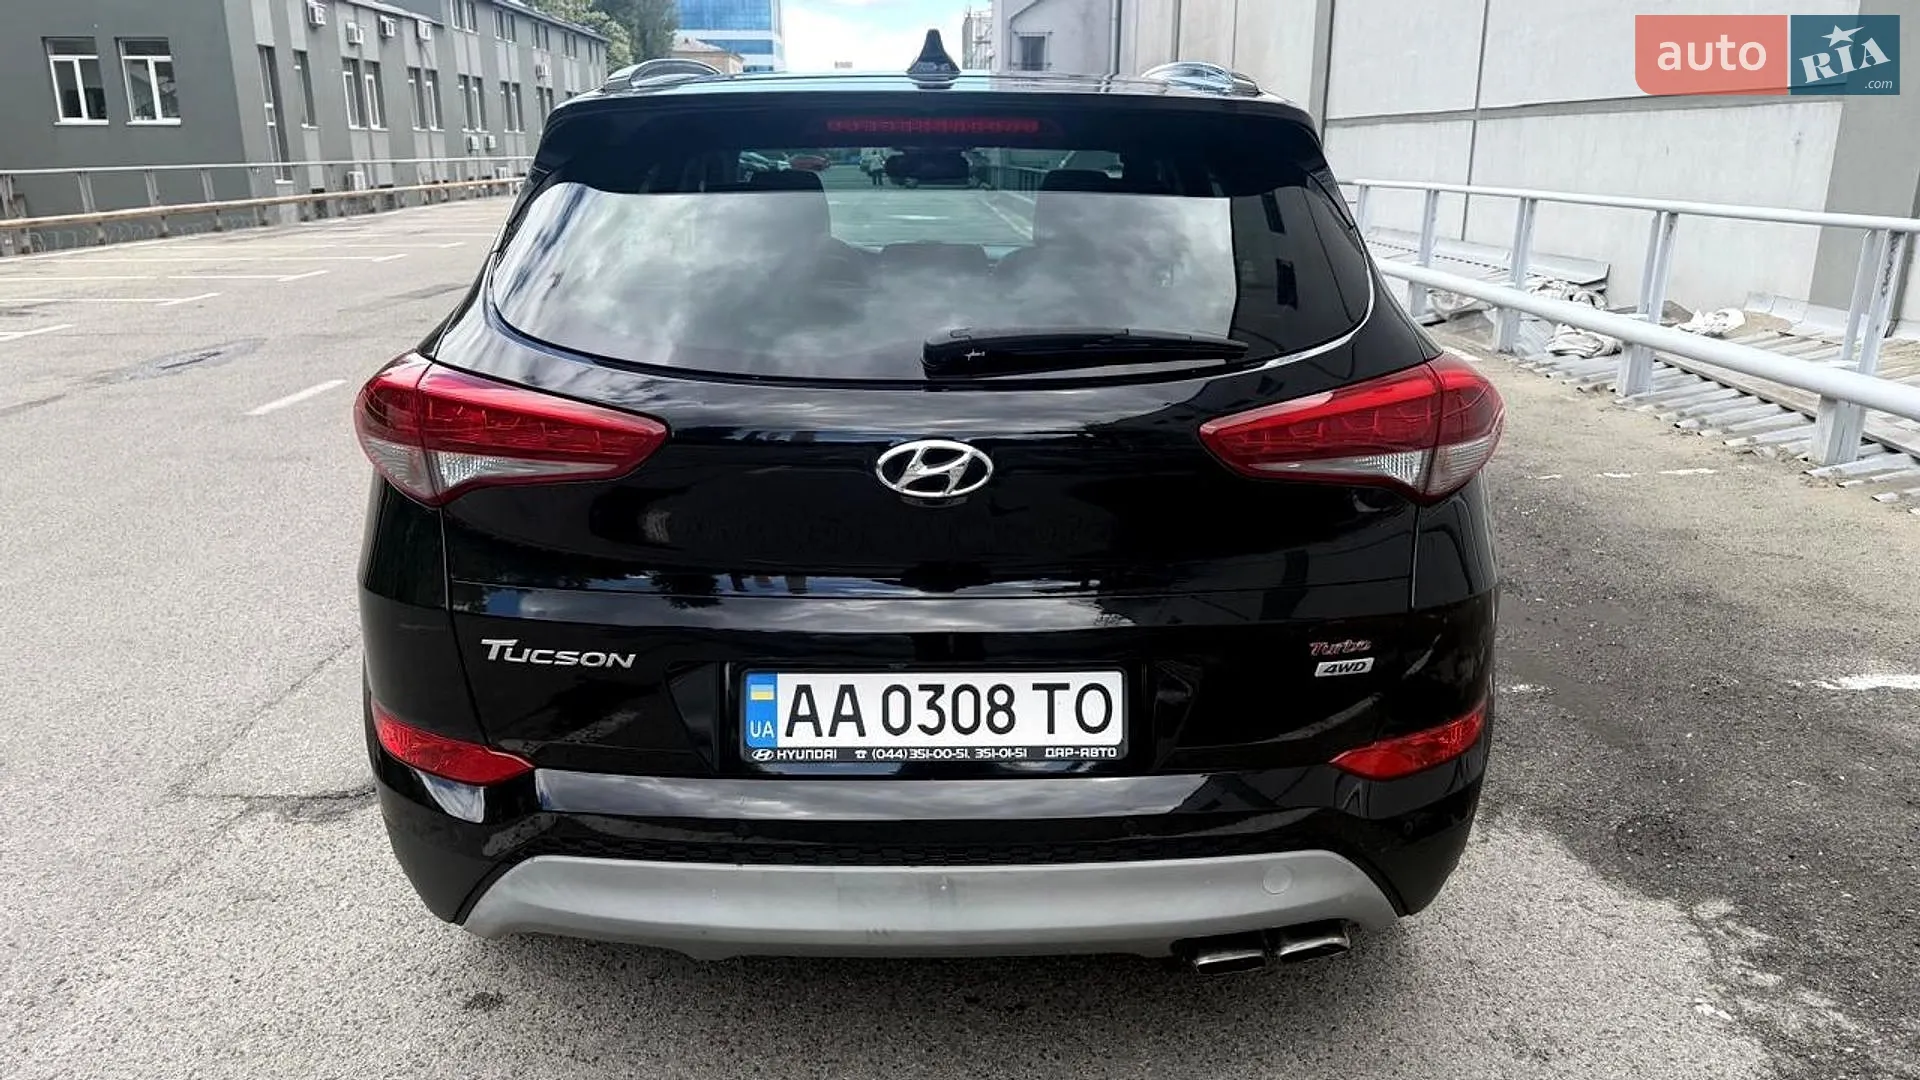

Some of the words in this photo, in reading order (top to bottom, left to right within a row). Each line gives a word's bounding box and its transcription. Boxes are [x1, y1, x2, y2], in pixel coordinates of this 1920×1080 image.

[1323, 661, 1367, 673] 4WD
[784, 684, 866, 737] AA
[882, 684, 1016, 736] 0308
[1032, 682, 1113, 734] TO
[750, 720, 775, 738] UA
[777, 749, 837, 760] HYUNDAI
[975, 748, 1027, 758] 351-01-51
